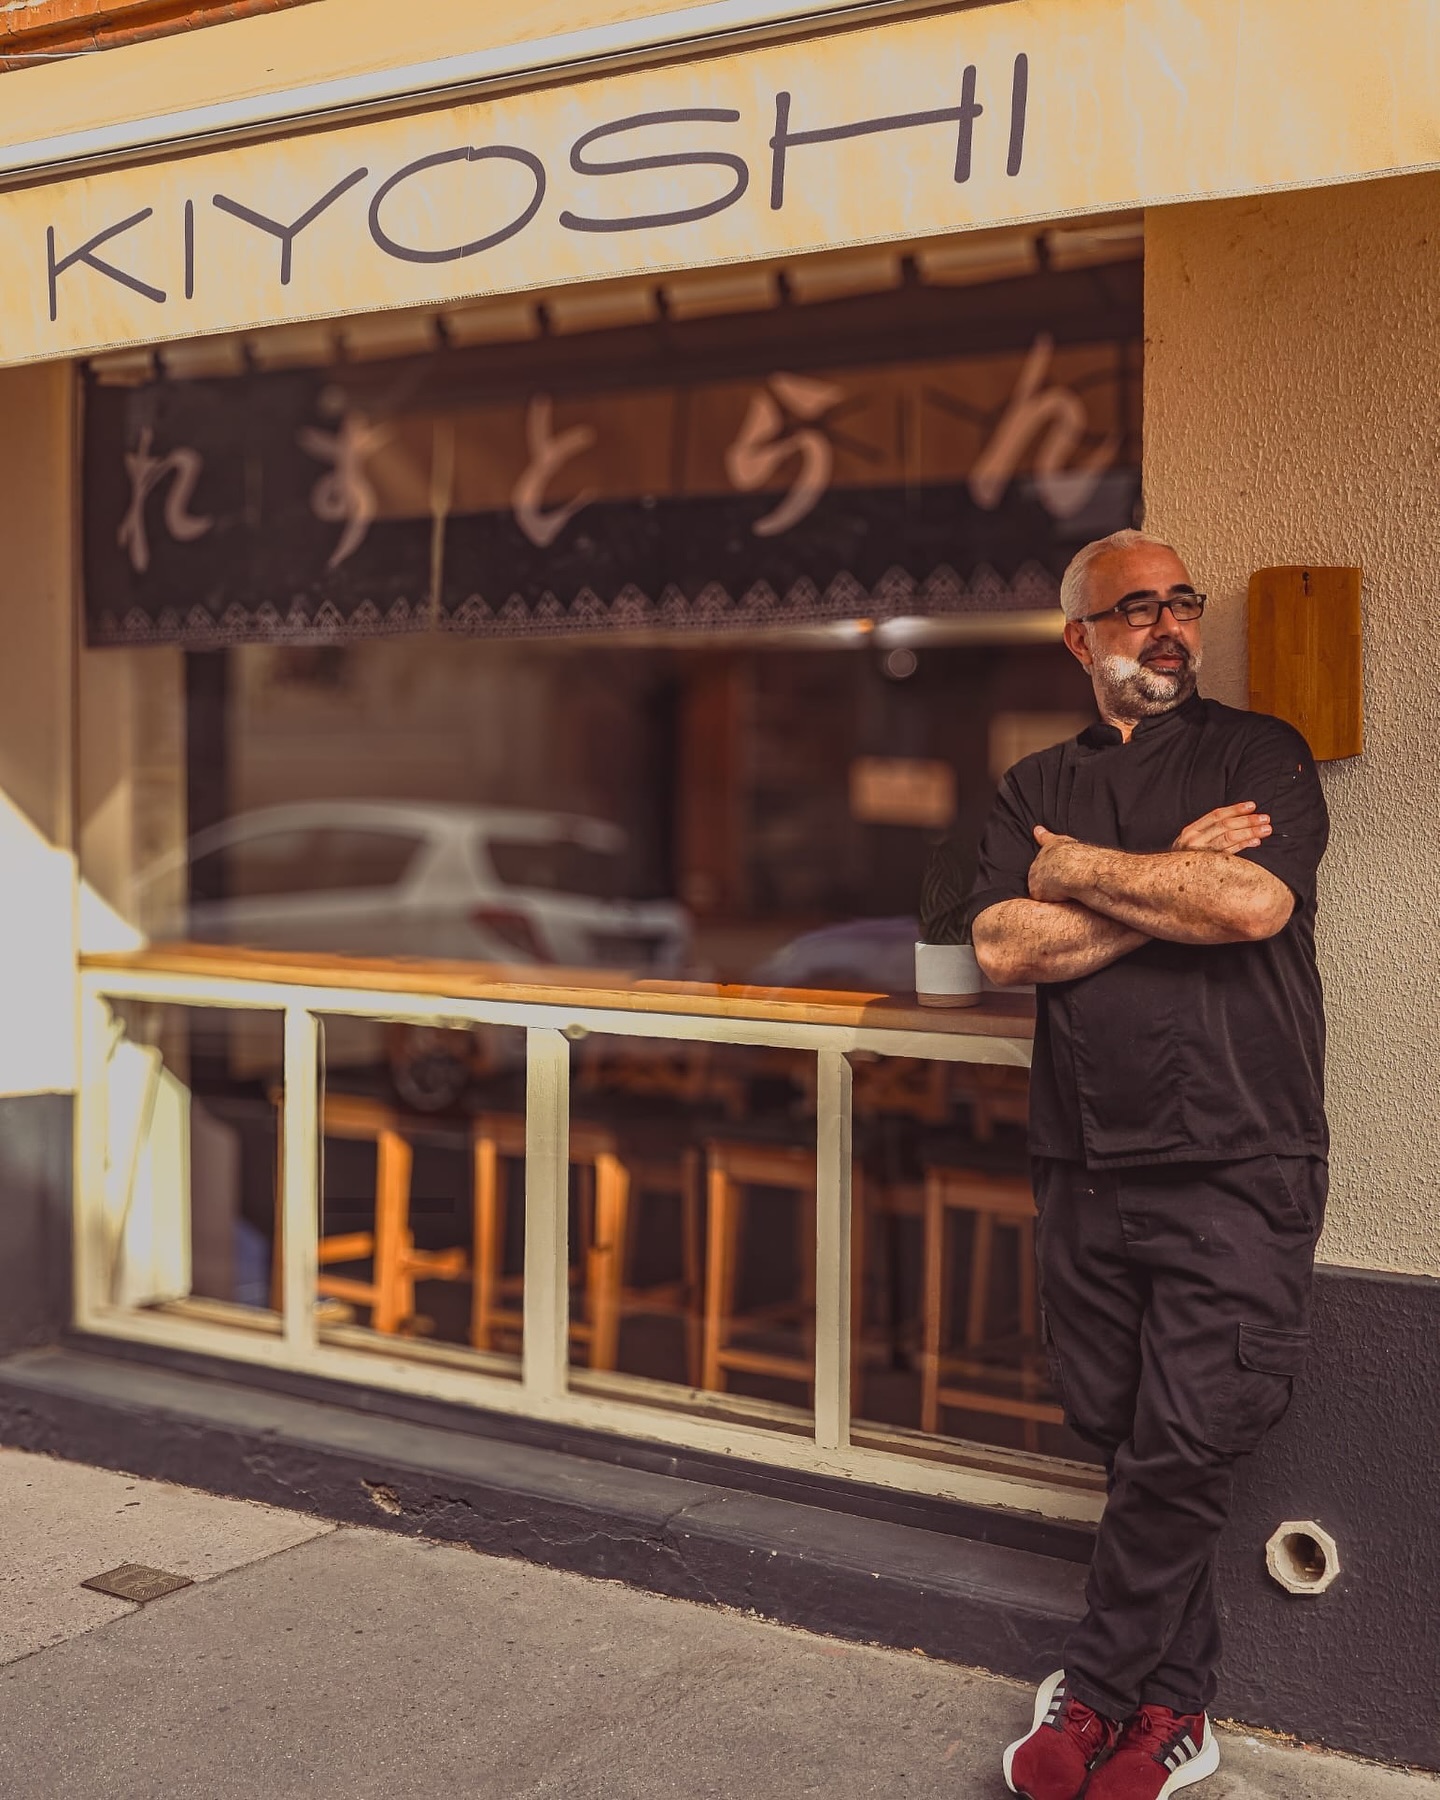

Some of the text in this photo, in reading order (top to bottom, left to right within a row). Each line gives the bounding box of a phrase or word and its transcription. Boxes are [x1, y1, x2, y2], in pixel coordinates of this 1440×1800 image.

[47, 53, 1028, 321] KIYOSHI
[117, 335, 1121, 571] れすとらん
